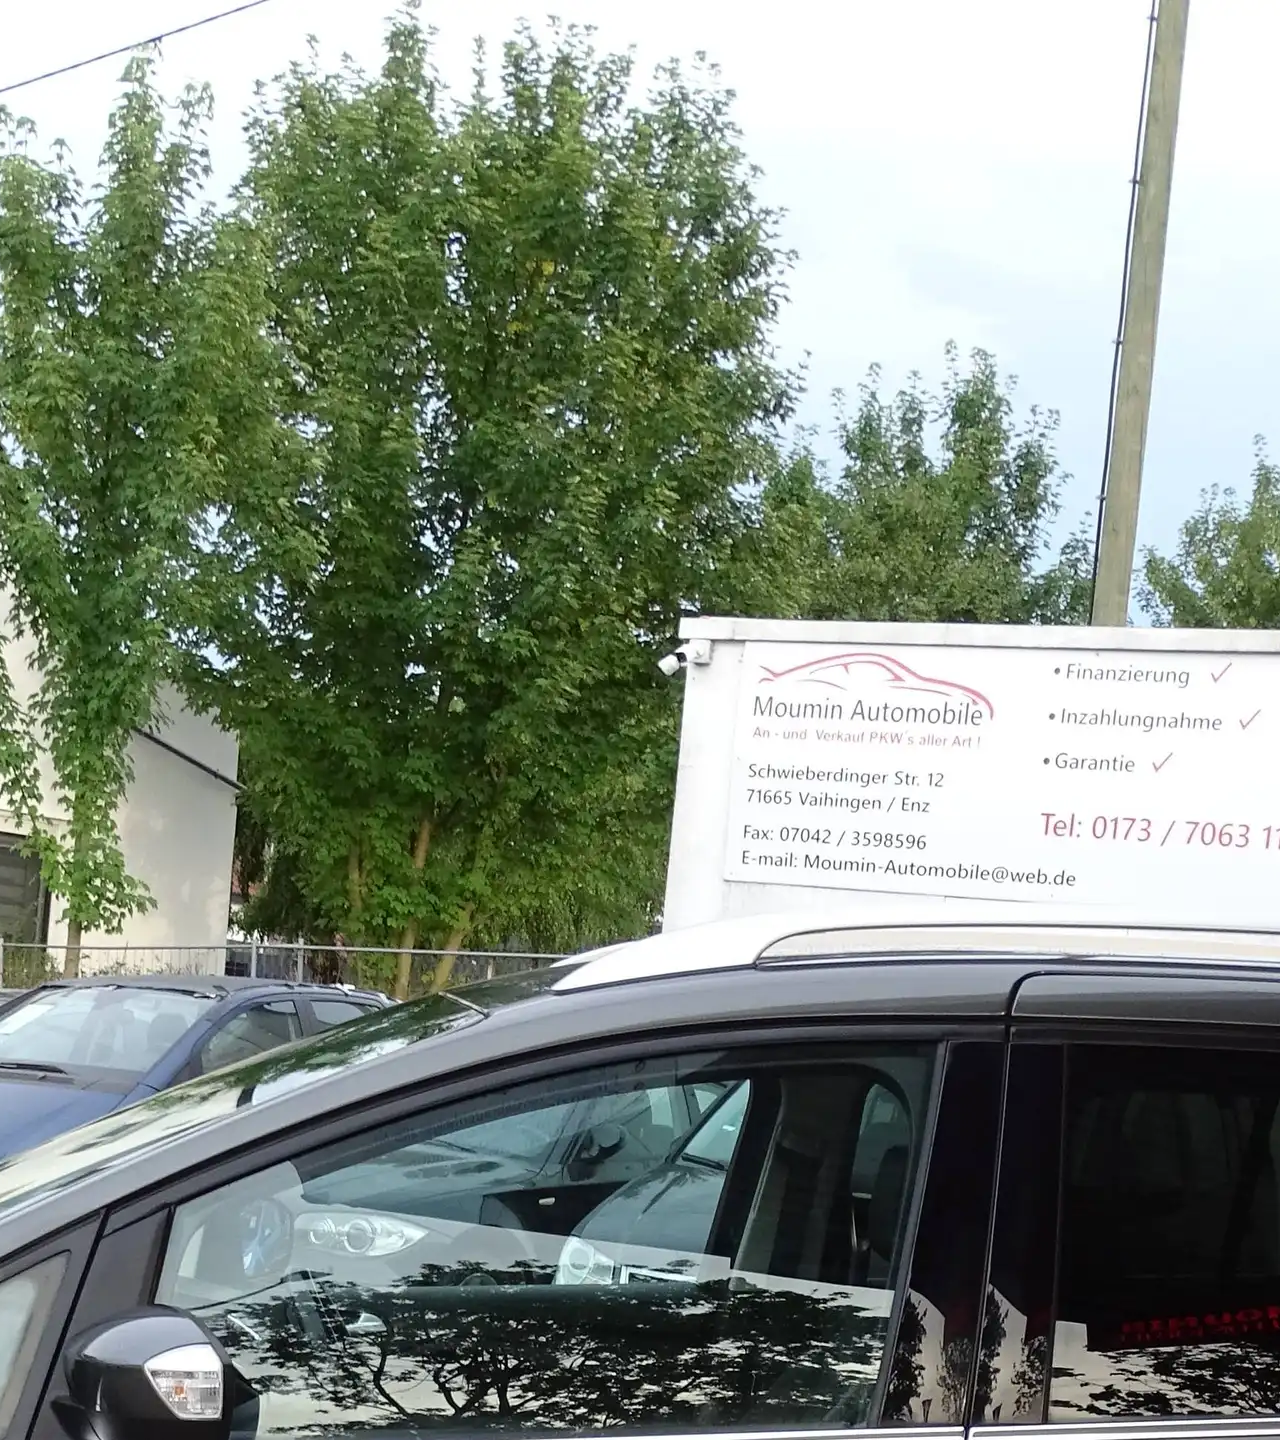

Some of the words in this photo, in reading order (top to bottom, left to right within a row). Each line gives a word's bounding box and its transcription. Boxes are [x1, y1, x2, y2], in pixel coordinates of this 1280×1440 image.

[1066, 663, 1190, 689] Finanzierung
[753, 695, 843, 720] Moumin
[851, 699, 983, 727] Automobile
[1061, 707, 1223, 733] Inzahlungnahme
[752, 726, 770, 738] An
[782, 728, 808, 740] und
[815, 729, 865, 743] Verkauf
[918, 733, 948, 747] aller
[951, 735, 972, 748] Art
[747, 763, 889, 788] Schwieberdinger
[894, 770, 921, 787] Str.
[928, 772, 944, 788] 12
[1055, 752, 1135, 773] Garantie
[747, 788, 792, 806] 71665
[798, 791, 882, 813] Vaihingen
[886, 796, 896, 813] /
[901, 797, 930, 813] Enz
[743, 824, 774, 841] Fax:
[779, 826, 832, 844] 07042
[836, 830, 846, 847] /
[851, 830, 927, 850] 3598596
[1040, 812, 1082, 838] Tel:
[1092, 815, 1152, 842] 0173
[1160, 820, 1176, 847] /
[1185, 821, 1250, 849] 7063
[741, 850, 798, 868] E-mail:
[803, 854, 1078, 888] Moumin-Automobile@web.de
